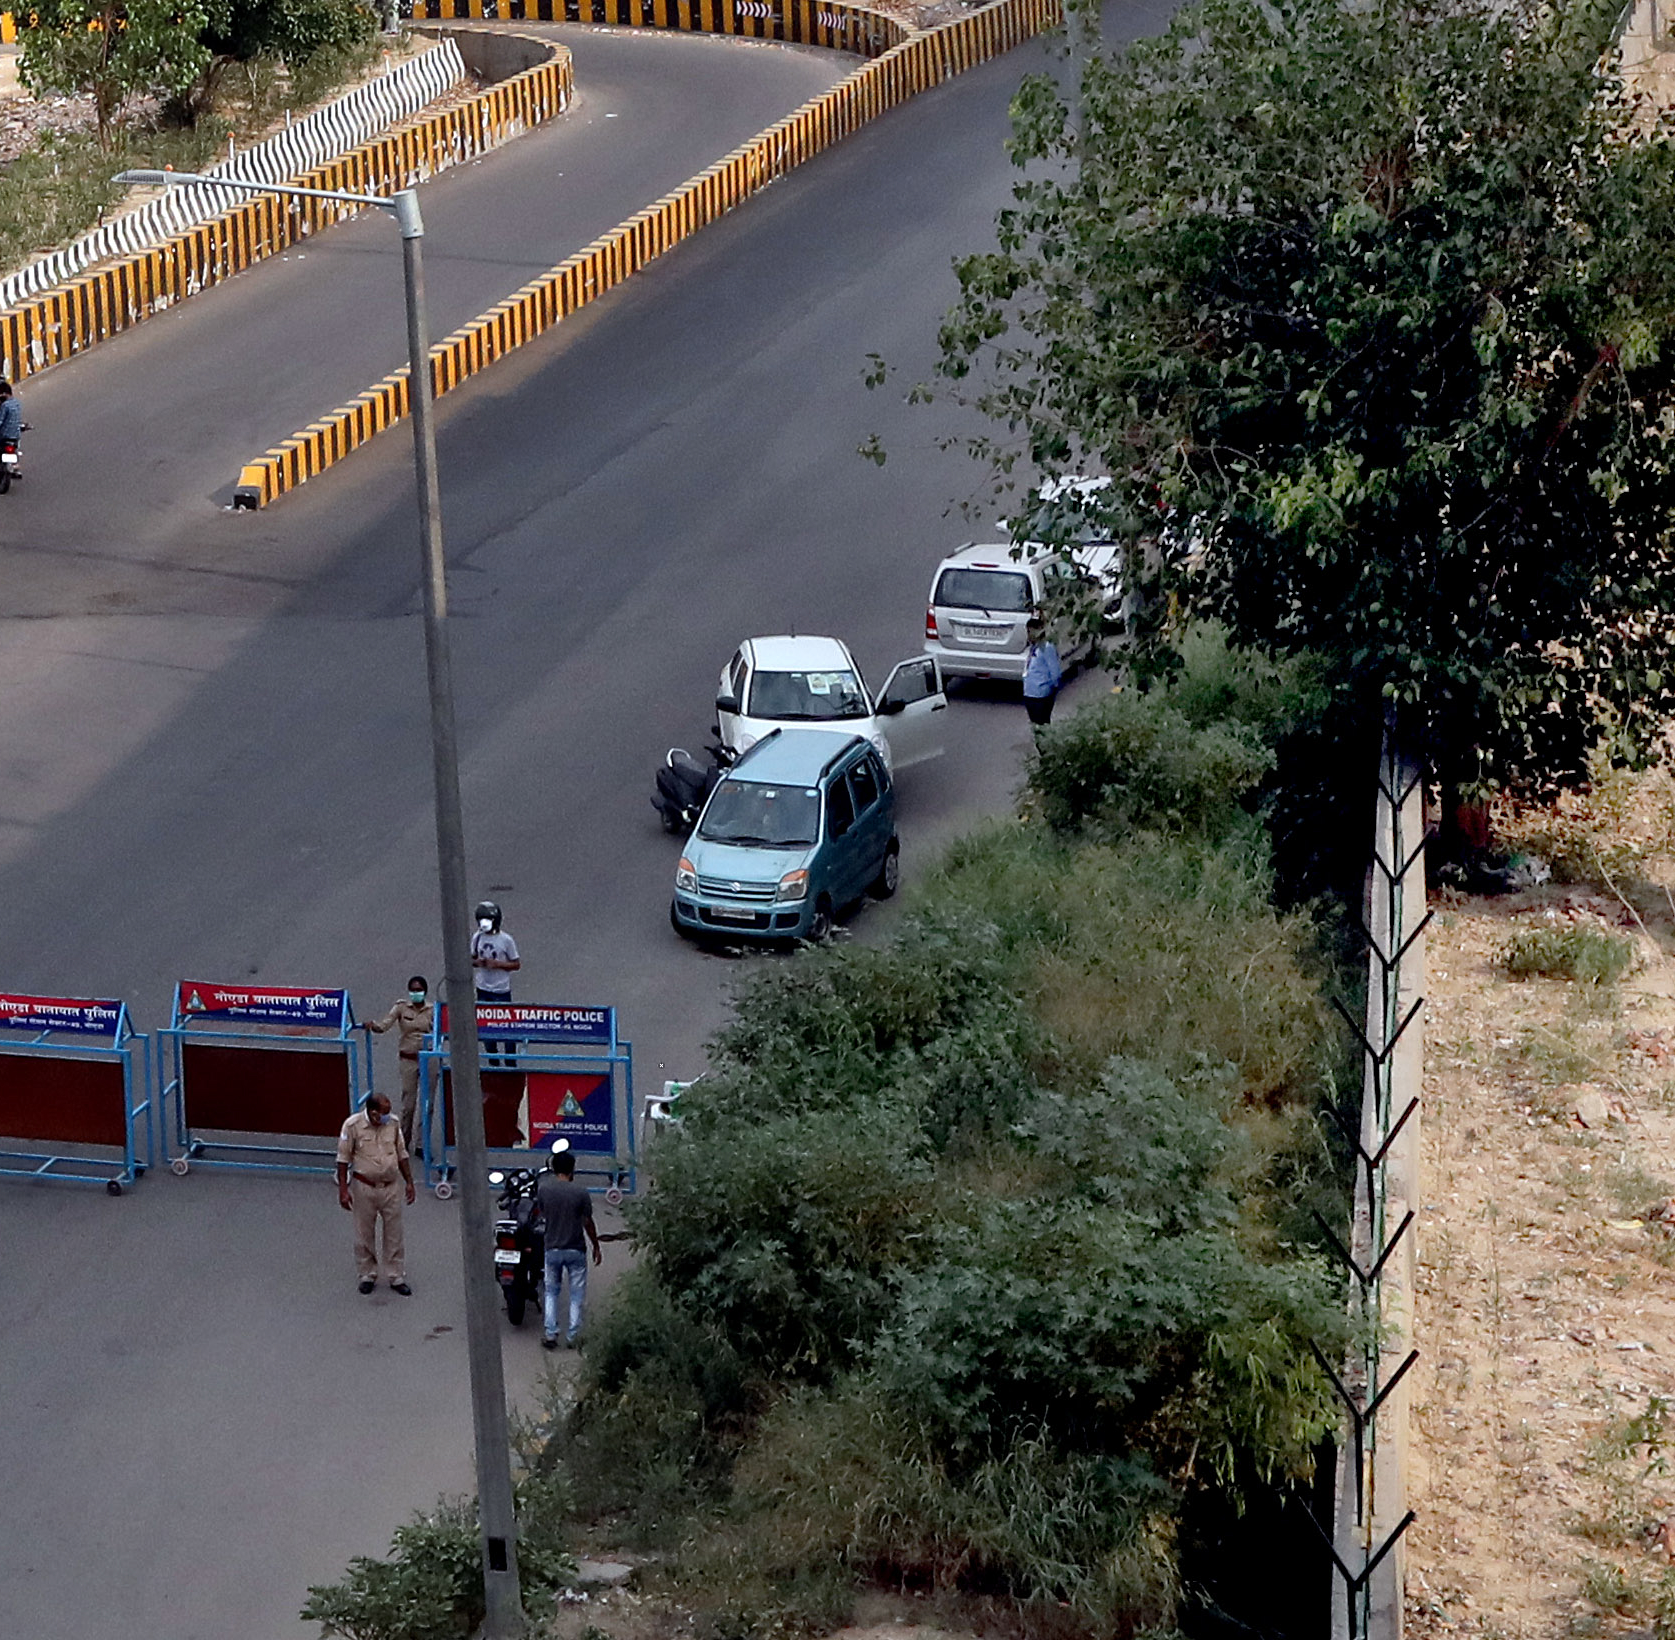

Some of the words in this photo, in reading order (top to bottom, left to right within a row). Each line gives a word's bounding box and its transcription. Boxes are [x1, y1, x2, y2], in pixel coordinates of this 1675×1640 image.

[214, 990, 248, 1005] नोएडा
[253, 994, 300, 1006] यातायात
[305, 994, 339, 1010] पुलिस
[33, 1004, 80, 1017] यातायात
[84, 1005, 117, 1022] पुलिस
[476, 1008, 511, 1020] NOIDA
[514, 1009, 561, 1022] TRAFFIC
[564, 1010, 604, 1023] POLICE
[533, 1121, 554, 1129] NOIDA
[555, 1122, 582, 1131] TRAFFIC
[584, 1123, 608, 1132] POLICE
